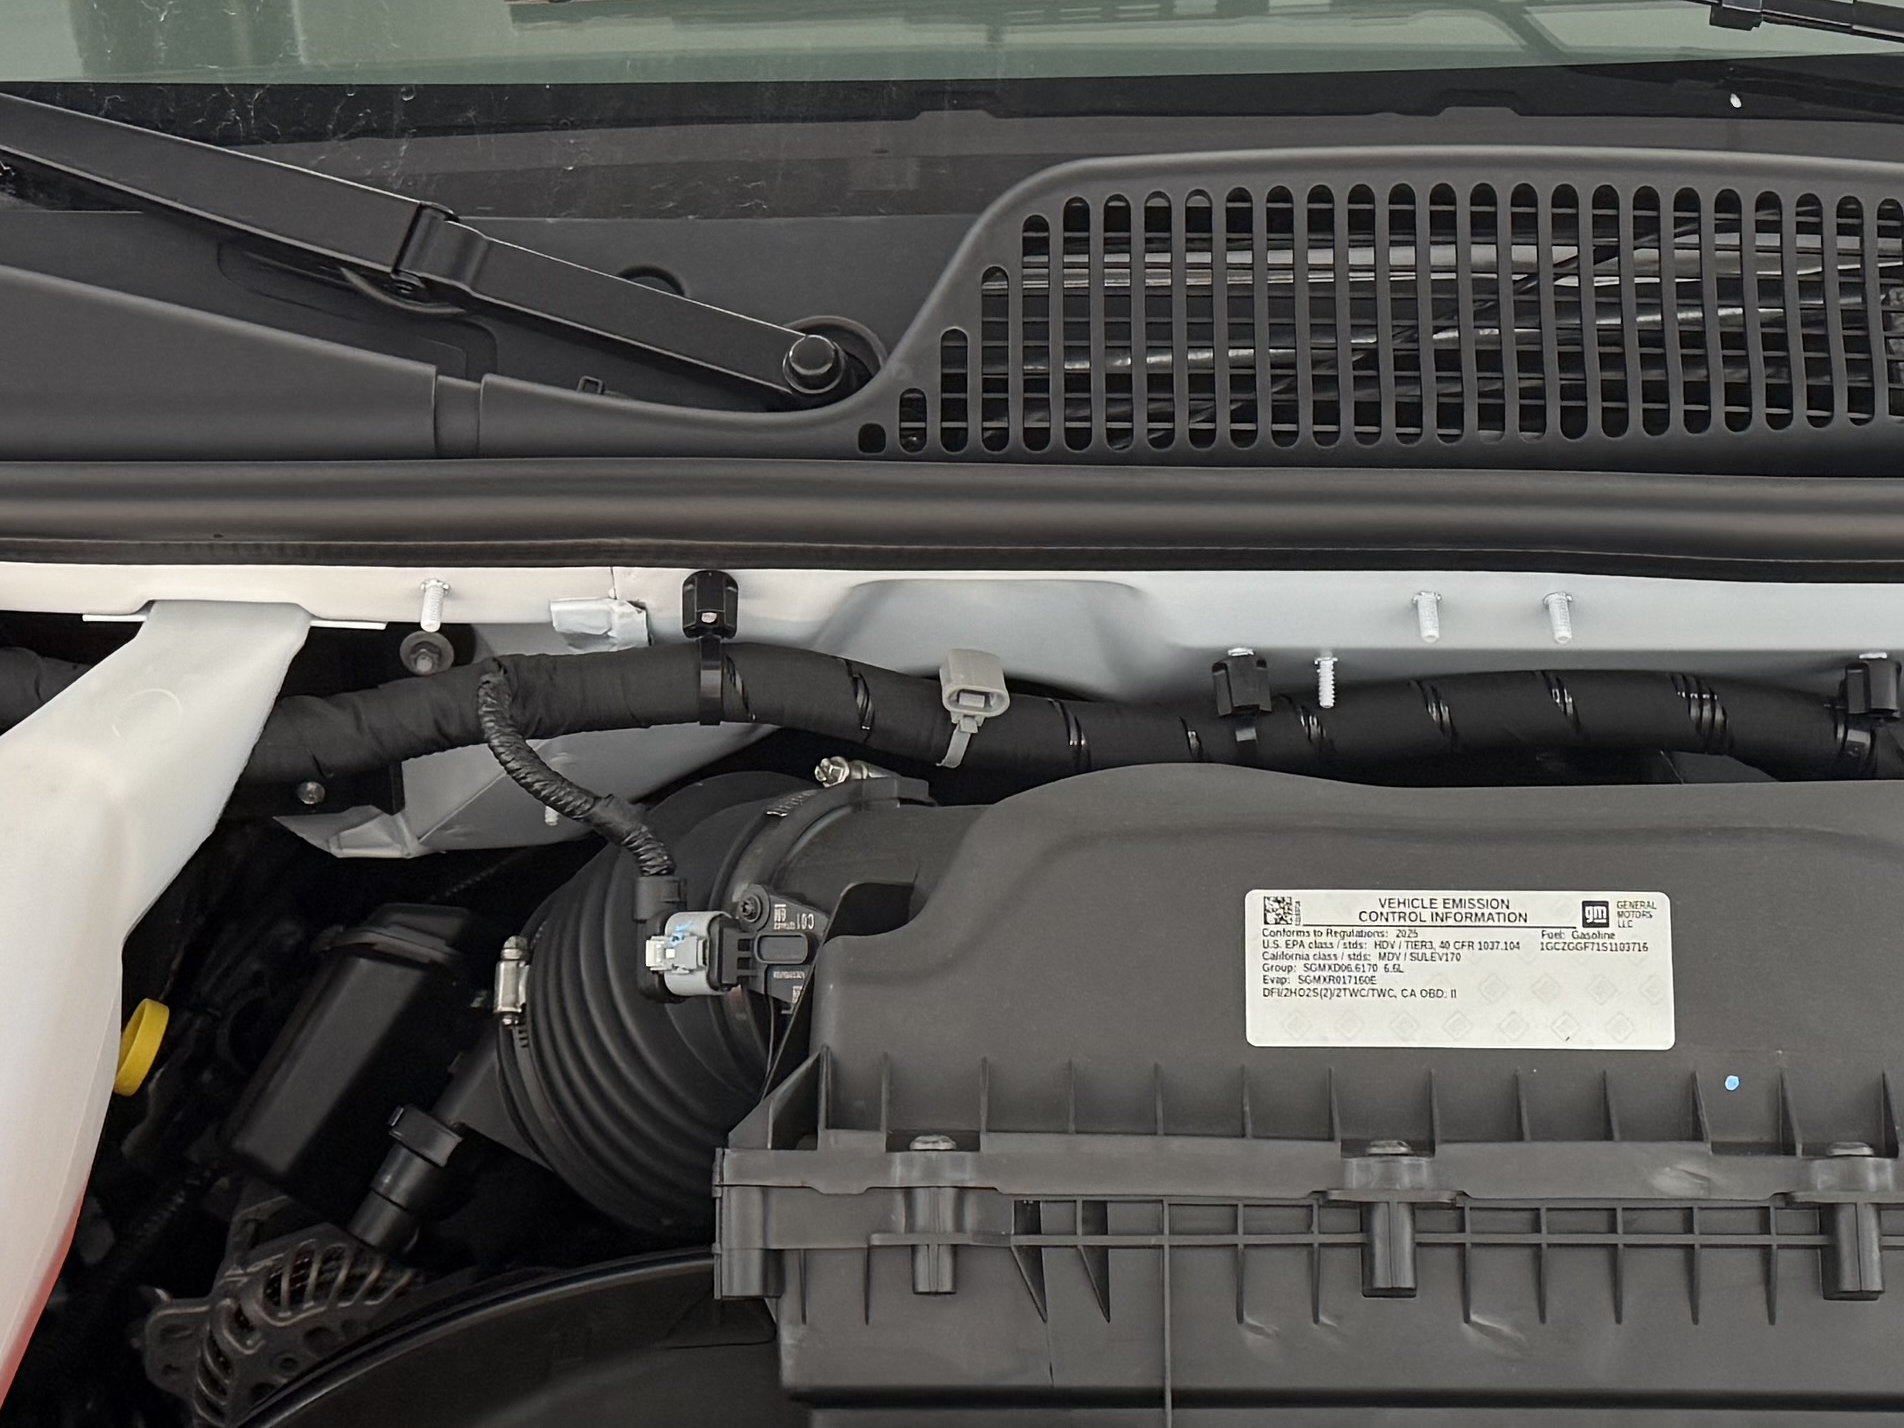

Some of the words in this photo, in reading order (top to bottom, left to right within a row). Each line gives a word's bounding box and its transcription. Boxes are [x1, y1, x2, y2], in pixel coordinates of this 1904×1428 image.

[1378, 897, 1438, 910] VEHICLE
[1442, 897, 1510, 910] EMISSION
[1616, 900, 1657, 910] GENERAL
[1358, 910, 1426, 922] CONTROL
[1430, 911, 1528, 923] INFORMATION
[1616, 910, 1653, 919] MOTORS
[1617, 919, 1633, 928] LLC
[1262, 928, 1311, 938] Conforms
[1313, 928, 1323, 938] to
[1326, 928, 1389, 940] Regulations:
[1395, 929, 1419, 938] 2025
[1541, 930, 1565, 939] Fuel:
[1571, 930, 1616, 940] Gasoline
[1262, 940, 1282, 949] U.S.
[1284, 940, 1305, 949] EPA
[1308, 940, 1334, 949] class
[1343, 940, 1368, 949] stds:
[1374, 940, 1396, 949] HDV
[1453, 941, 1475, 950] CFR
[1478, 941, 1521, 951] 1037.104
[1540, 941, 1649, 952] 1GCZGGF71S1103716
[1262, 951, 1310, 961] California
[1312, 951, 1338, 961] class
[1347, 951, 1371, 961] stds:
[1378, 951, 1401, 962] MDV
[1410, 952, 1461, 962] SULEV170
[1262, 963, 1297, 973] Group:
[1262, 974, 1290, 986] Evap:
[1400, 988, 1417, 999] CA
